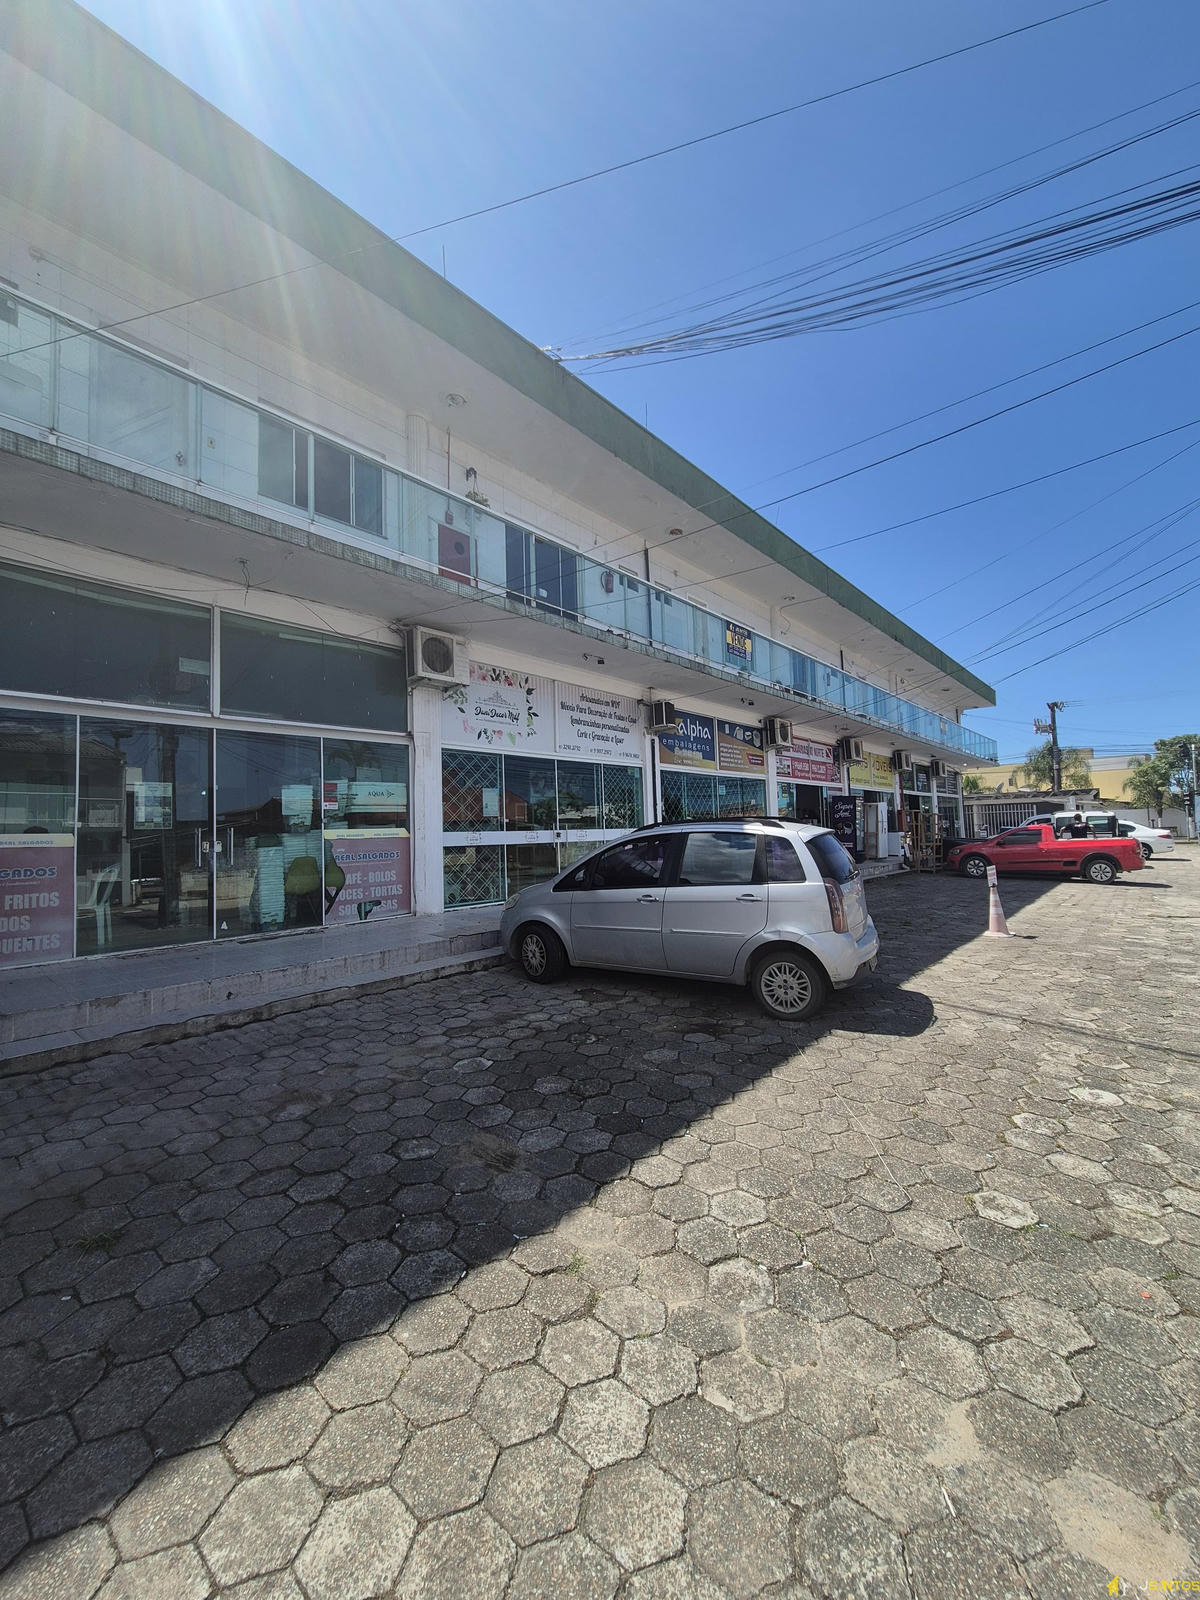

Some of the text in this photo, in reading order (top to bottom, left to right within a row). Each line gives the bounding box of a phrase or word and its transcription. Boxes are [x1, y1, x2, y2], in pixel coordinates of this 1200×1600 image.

[677, 718, 711, 741] alpha
[662, 738, 711, 752] embalagens
[357, 851, 400, 861] SALGADOS
[345, 872, 362, 886] AFÉ
[369, 870, 397, 883] BOLOS
[4, 891, 60, 911] FRITOS
[338, 887, 364, 901] OCES
[371, 884, 403, 898] TORTAS
[0, 934, 60, 954] UENTES
